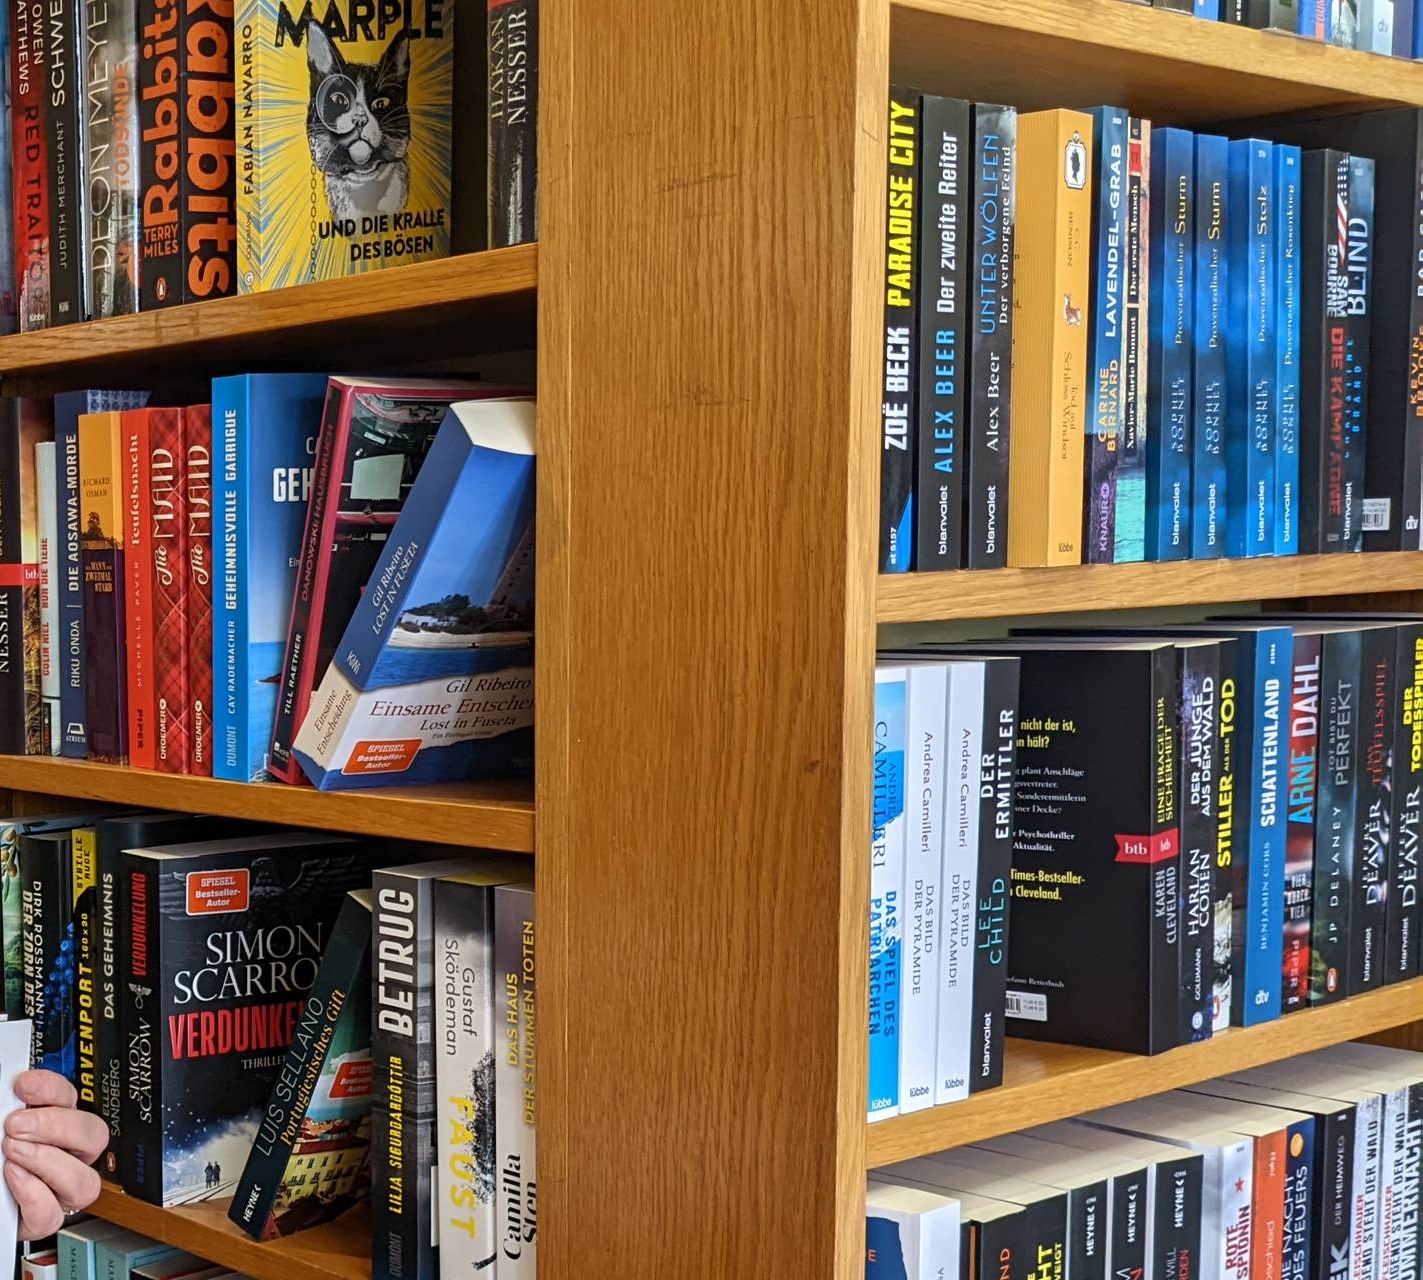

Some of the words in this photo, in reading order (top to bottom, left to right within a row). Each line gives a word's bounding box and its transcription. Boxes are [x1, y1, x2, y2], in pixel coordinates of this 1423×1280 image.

[275, 0, 443, 48] MARPLE
[243, 25, 252, 119] NAVARRO
[508, 8, 527, 126] NESSER
[25, 105, 40, 163] RED
[244, 125, 253, 195] FABIAN
[890, 100, 915, 166] CITY
[938, 132, 958, 197] Reiter
[90, 143, 113, 272] DEON
[983, 134, 999, 247] WÖLFEN
[1176, 176, 1186, 233] Sturm
[1209, 183, 1220, 240] Sturm
[27, 176, 45, 299] TRAITOR
[144, 224, 177, 242] TERRY
[144, 239, 177, 259] MILES
[319, 220, 356, 239] UND
[362, 216, 388, 235] DIE
[394, 209, 445, 231] KRALLE
[351, 242, 381, 262] DES
[384, 234, 433, 257] BÖSEN
[888, 176, 912, 307] PARADISE
[940, 204, 956, 268] zweite
[1106, 144, 1121, 337] LAVENDEL-GRAB
[937, 275, 953, 313] Der
[981, 253, 995, 335] UNTER
[1348, 218, 1368, 315] BLIND
[887, 327, 909, 392] BECK
[935, 330, 954, 394] BEER
[987, 352, 999, 400] Beer
[882, 402, 908, 450] ZOË
[987, 407, 998, 450] Alex
[1099, 368, 1109, 441] CARINE
[1107, 360, 1118, 450] BERNARD
[224, 410, 237, 482] GARRIGUE
[933, 411, 952, 474] ALEX
[152, 449, 174, 538] MAID
[188, 445, 210, 536] MAID
[25, 569, 39, 579] btb
[154, 545, 173, 585] The
[191, 542, 208, 583] The
[224, 491, 237, 610] GEHEIMNISVOLLE
[373, 585, 383, 607] Gil
[380, 546, 404, 588] Ribeiro
[372, 605, 389, 636] LOST
[387, 588, 396, 605] IN
[393, 541, 418, 590] FUSETA
[284, 690, 294, 716] TILL
[289, 634, 301, 684] RAETHER
[347, 651, 361, 674] KiWi
[446, 679, 472, 694] Gil
[476, 676, 532, 693] Ribeiro
[314, 690, 337, 732] Einsame
[316, 690, 351, 756] Entscheidung
[420, 719, 452, 731] Lost
[456, 719, 468, 729] in
[473, 715, 517, 729] Fuseta
[1021, 719, 1042, 731] nicht
[1045, 718, 1058, 731] der
[1062, 719, 1076, 732] ist,
[1220, 679, 1234, 735] TOD
[1292, 656, 1319, 736] DAHL
[356, 753, 406, 762] Bestseller-
[368, 744, 405, 752] SPIEGEL
[924, 731, 933, 782] Andrea
[1027, 735, 1050, 748] hält?
[1191, 692, 1203, 771] JUNGE
[1261, 679, 1280, 827] SCHATTENLAND
[1335, 680, 1352, 786] PERFEKT
[364, 760, 392, 769] Autor
[981, 754, 995, 798] DER
[996, 709, 1014, 839] ERMITTLER
[1191, 778, 1200, 805] DER
[1288, 747, 1315, 824] ARNE
[921, 789, 933, 853] Camilleri
[1013, 842, 1054, 852] Aktualität.
[1125, 842, 1147, 855] btb
[1218, 775, 1233, 868] STILLER
[1366, 801, 1380, 905] DEAVER
[1402, 786, 1419, 908] DEAVER
[195, 888, 241, 898] Bestseller-
[201, 877, 235, 887] SPIEGEL
[207, 898, 230, 907] Autor
[1015, 887, 1062, 900] Cleveland.
[1189, 849, 1200, 937] HARLAN
[1200, 853, 1210, 926] COBEN
[102, 873, 113, 980] GEHEIMNIS
[132, 873, 146, 977] VERDUNKELUNG
[205, 923, 323, 967] SIMON
[979, 897, 992, 949] LEE
[991, 877, 1004, 964] CHILD
[378, 889, 414, 1037] BETRUG
[523, 921, 534, 990] TOTEN
[105, 986, 114, 1019] DAS
[445, 940, 457, 1056] Skördeman
[461, 968, 477, 1036] Gustaf
[507, 973, 517, 1024] HAUS
[80, 963, 94, 1103] DAVENPORT
[507, 1031, 517, 1065] DAS
[523, 995, 535, 1082] STUMMEN
[110, 1059, 121, 1137] SANDBERG
[139, 1018, 152, 1123] SCARROW
[256, 1104, 285, 1158] LUIS
[276, 997, 324, 1104] SELLANO
[280, 1026, 333, 1146] Portugiesisches
[326, 988, 346, 1031] Gift
[389, 1056, 402, 1167] SIGURDARDÓTTIR
[524, 1088, 535, 1125] DER
[389, 1169, 402, 1214] LILJA
[449, 1096, 476, 1239] FAUST
[1336, 1136, 1344, 1199] HEIMWEG
[244, 1192, 258, 1223] HEYNE
[503, 1154, 522, 1260] Camilla
[1226, 1223, 1238, 1271] ROTE
[1237, 1205, 1249, 1280] SPIONIN
